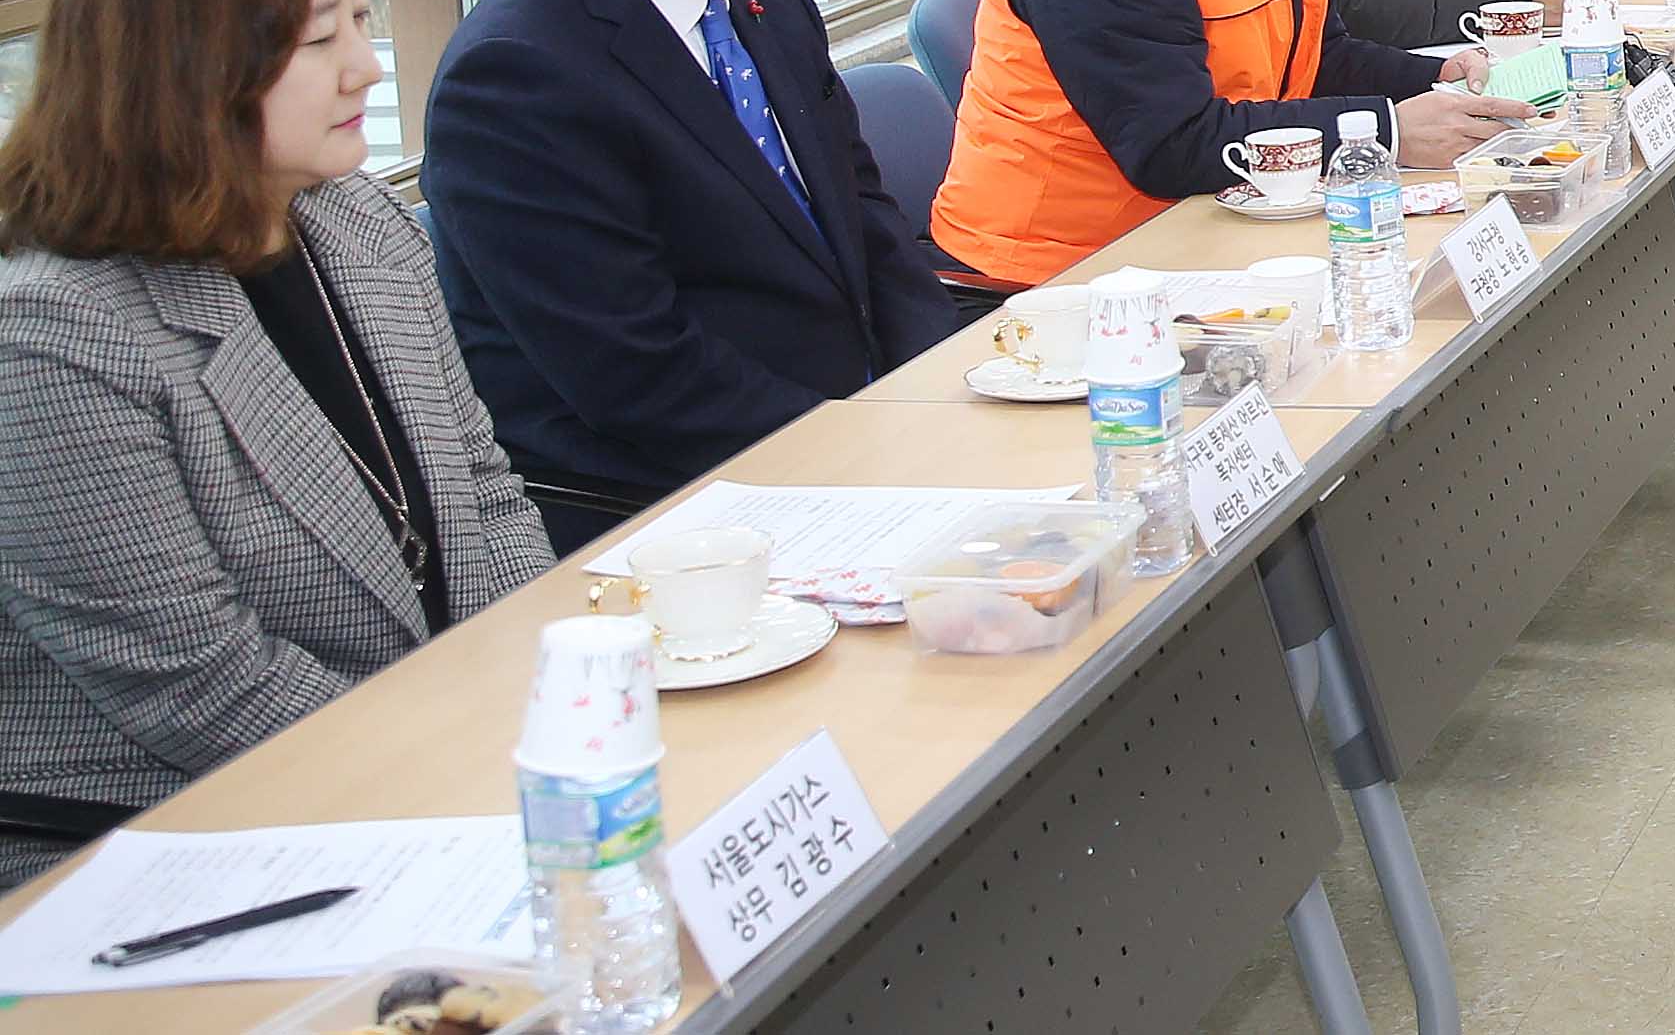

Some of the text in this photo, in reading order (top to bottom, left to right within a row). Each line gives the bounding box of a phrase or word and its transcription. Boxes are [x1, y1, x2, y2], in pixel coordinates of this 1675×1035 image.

[1466, 221, 1505, 263] 강서구청
[1470, 270, 1501, 302] 구청장
[1208, 417, 1243, 452] 봉제산
[1240, 393, 1270, 426] 어르신
[1215, 440, 1257, 483] 복지센터
[1212, 490, 1250, 534] 센터장
[702, 773, 832, 890] 서울도시가스
[727, 884, 775, 943] 상무
